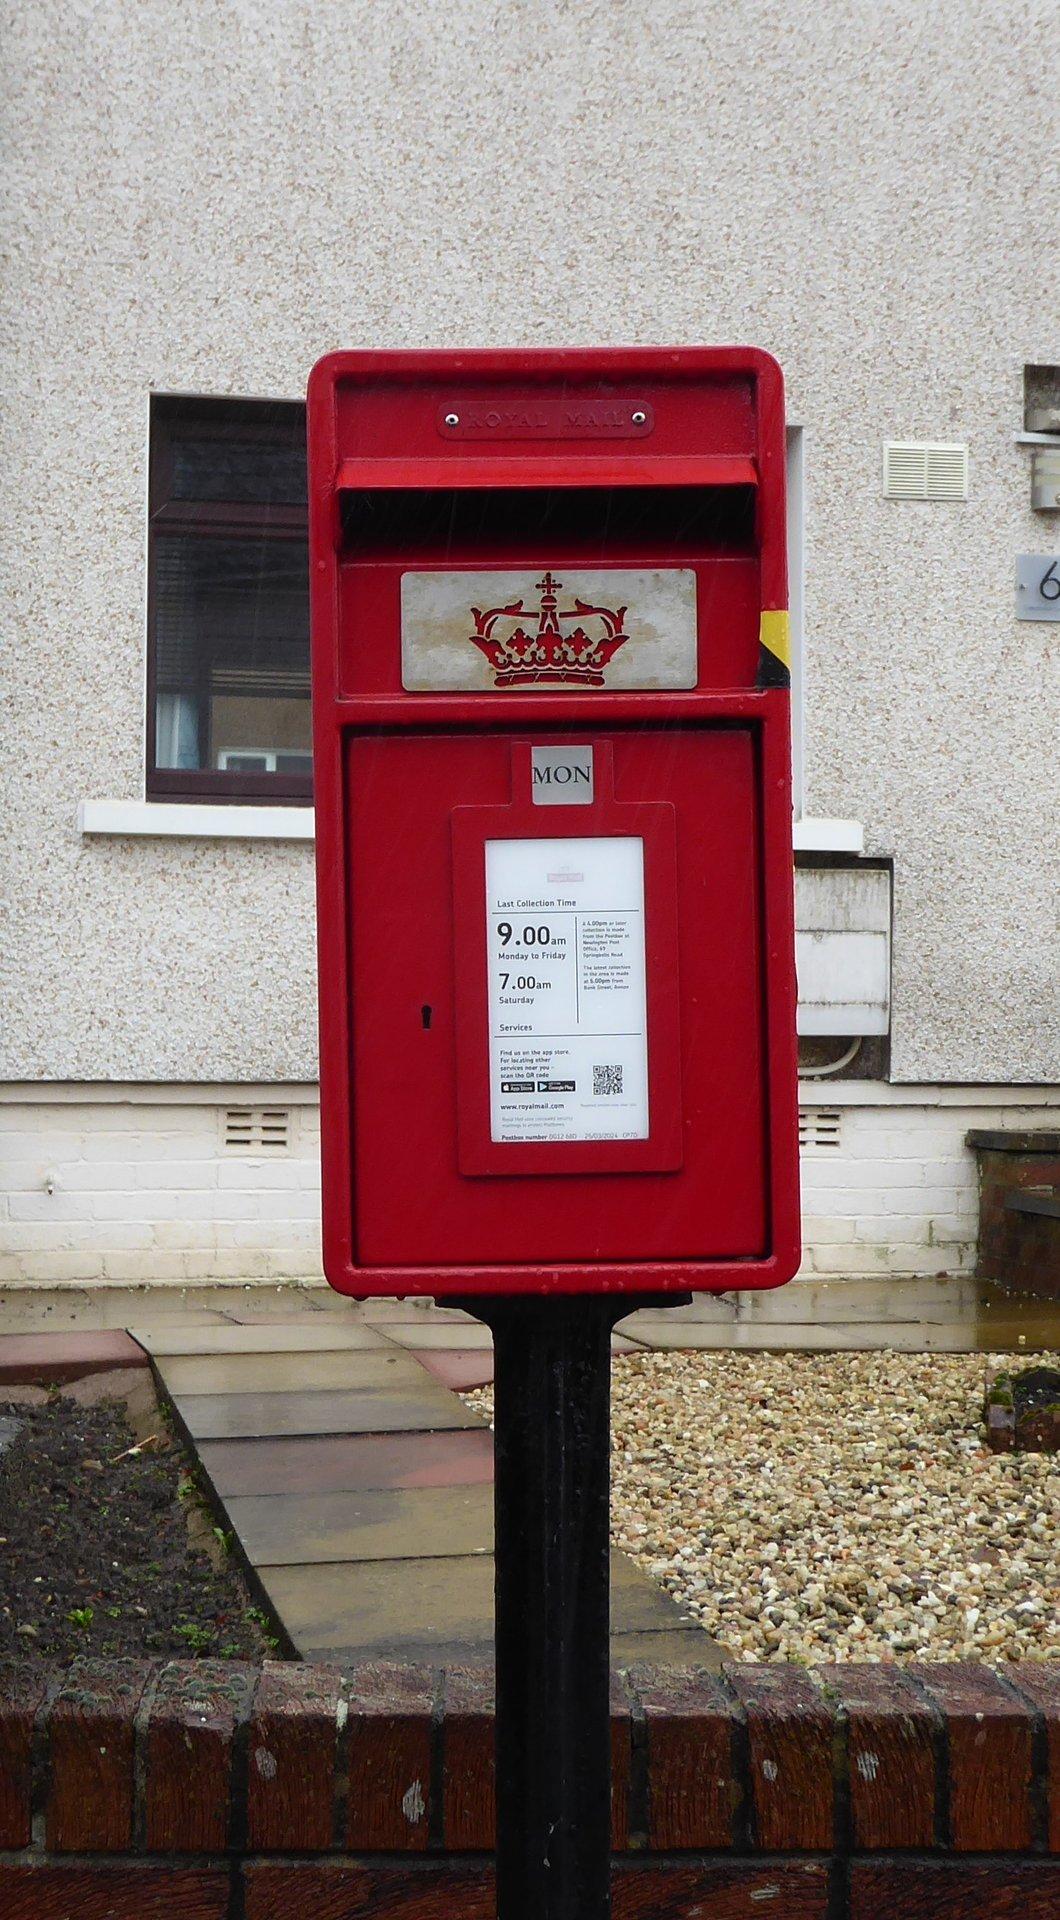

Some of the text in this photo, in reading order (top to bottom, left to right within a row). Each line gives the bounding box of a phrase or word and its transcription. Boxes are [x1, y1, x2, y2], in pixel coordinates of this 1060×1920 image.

[467, 411, 625, 428] ROYAL MAIL
[1039, 561, 1060, 601] 6
[532, 766, 591, 784] MON
[498, 952, 528, 961] Monday
[542, 952, 566, 961] Friday
[499, 996, 534, 1005] Saturday
